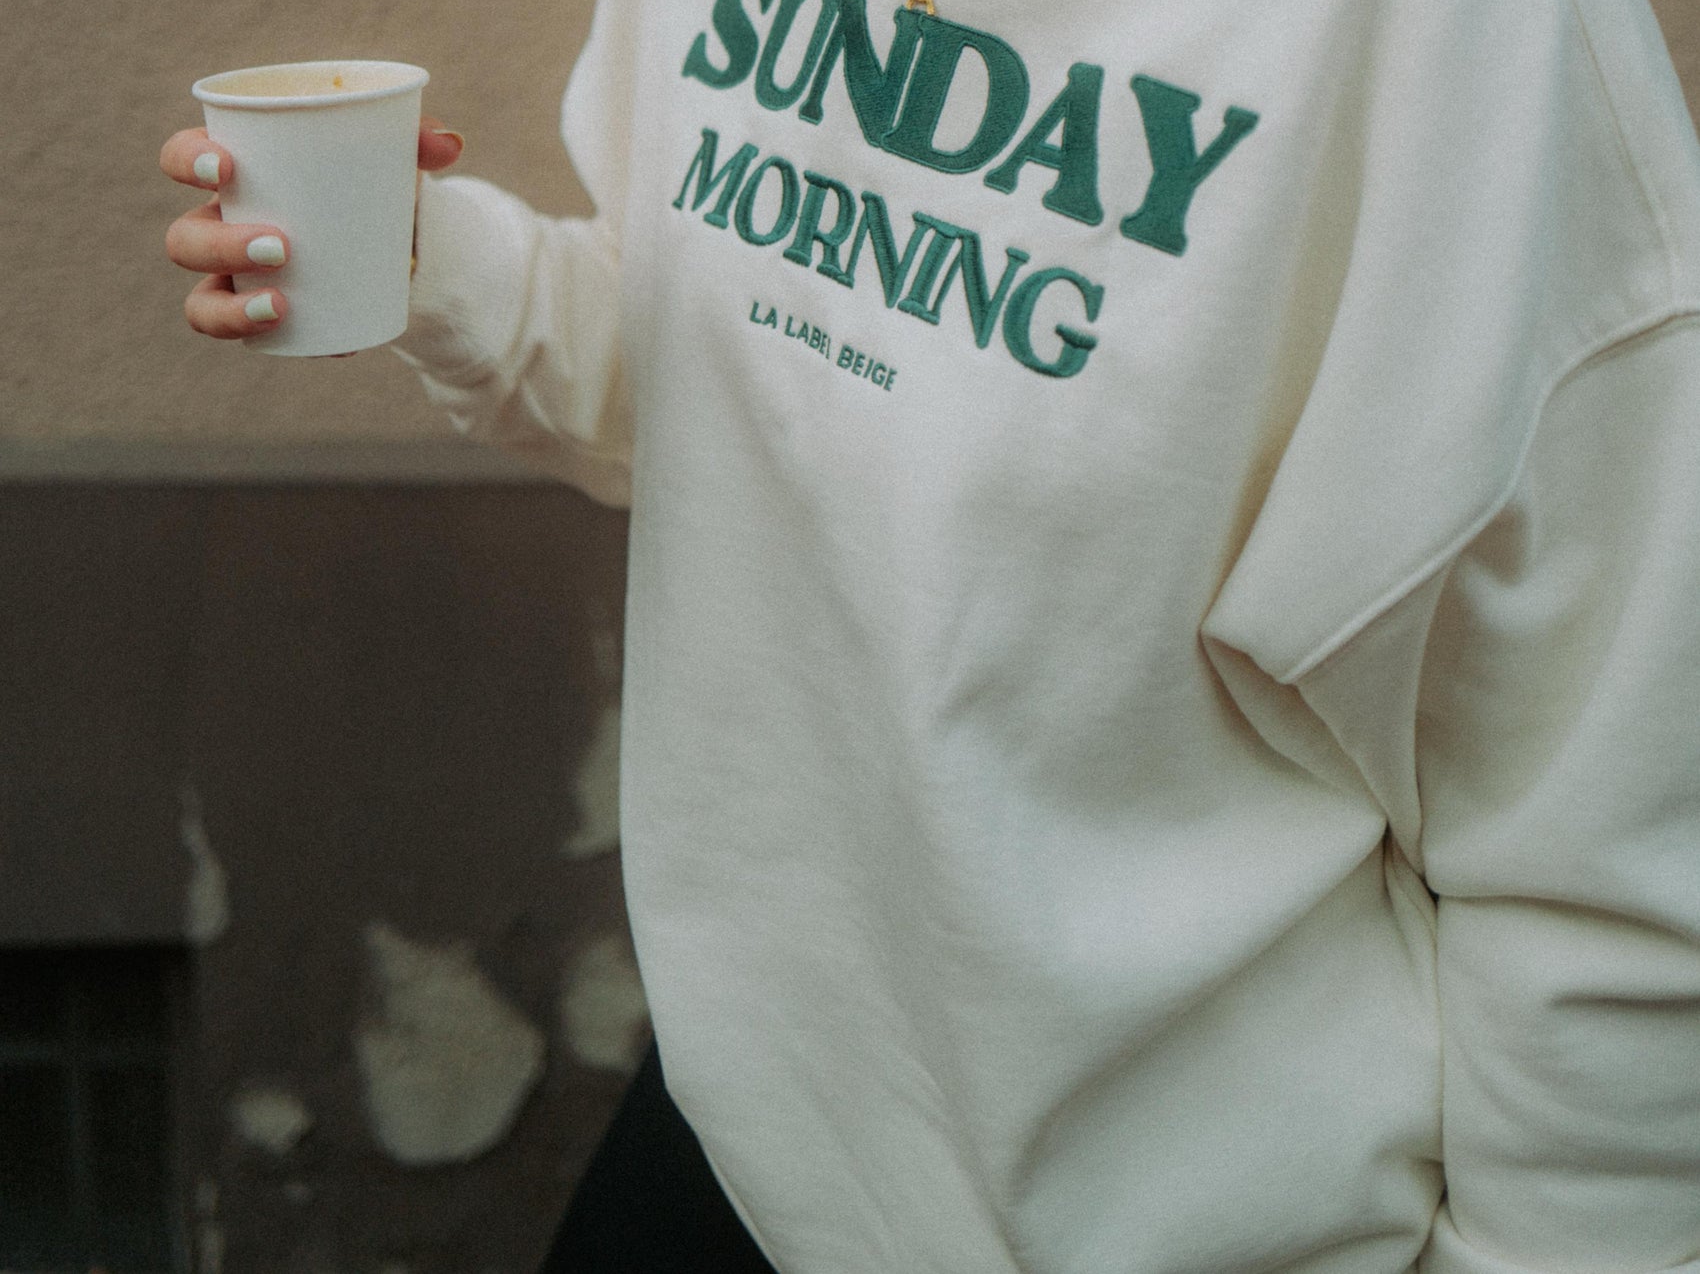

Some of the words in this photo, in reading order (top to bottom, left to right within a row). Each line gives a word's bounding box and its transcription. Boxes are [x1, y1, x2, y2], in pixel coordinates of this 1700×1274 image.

[672, 128, 1105, 379] MORNING
[750, 301, 777, 329] LA
[836, 344, 898, 392] BEIGE
